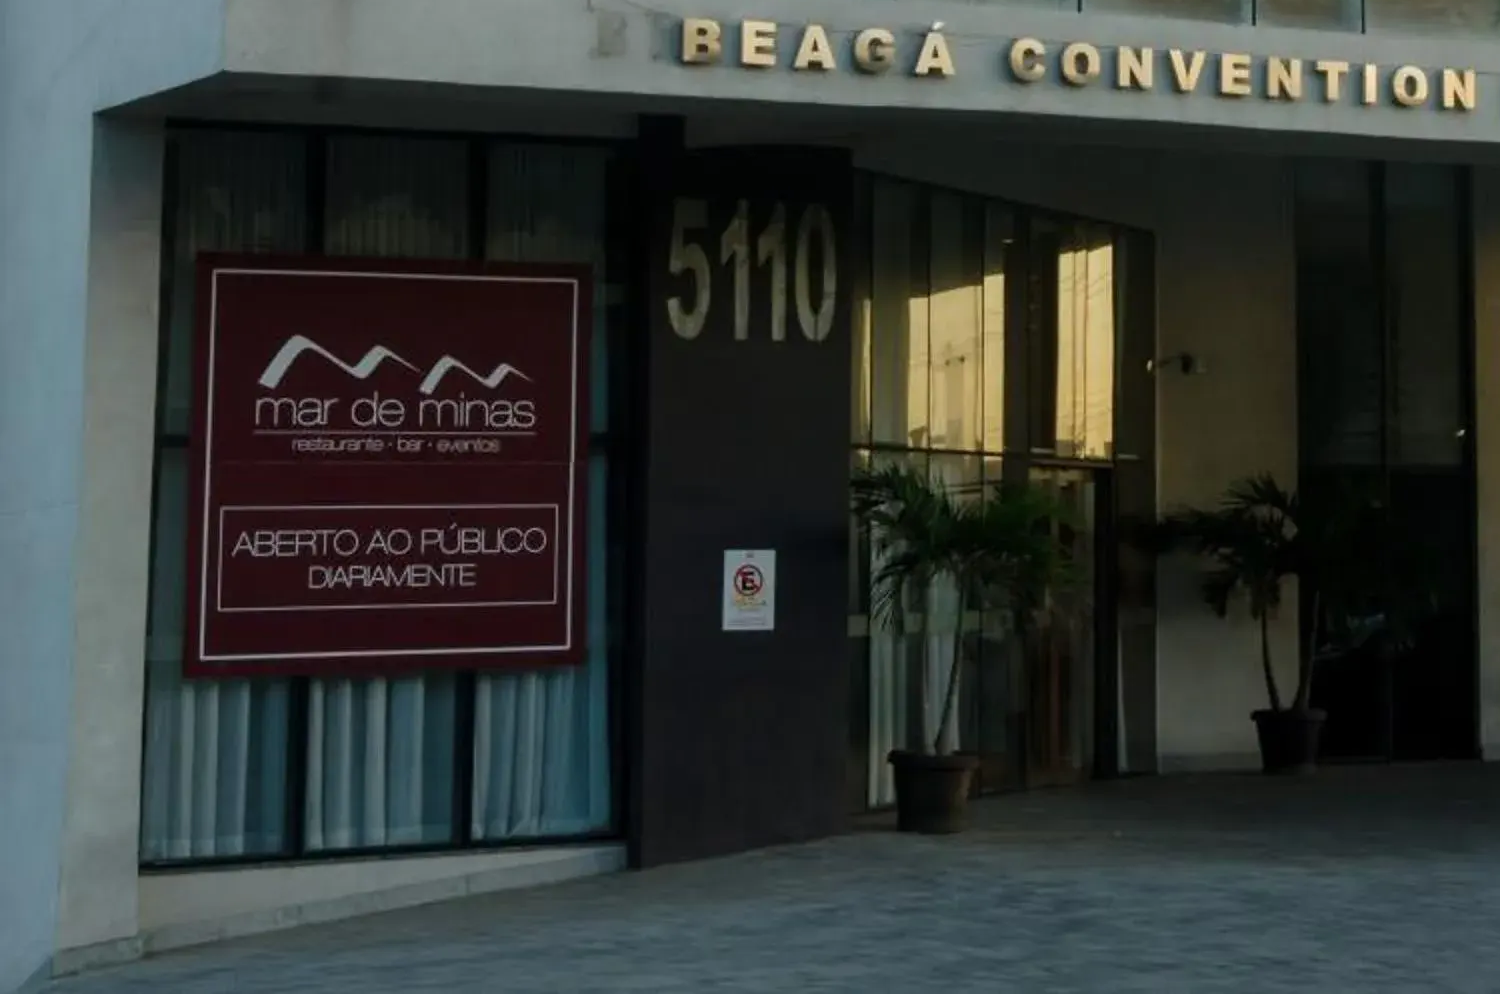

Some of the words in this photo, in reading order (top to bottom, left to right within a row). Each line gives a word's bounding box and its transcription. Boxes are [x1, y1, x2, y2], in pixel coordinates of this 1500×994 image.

[681, 18, 956, 77] BEAGÁ
[1008, 37, 1477, 111] CONVENTION
[667, 197, 837, 343] 5110
[254, 396, 339, 427] mar
[351, 391, 406, 428] de
[419, 391, 537, 430] minas
[291, 435, 385, 453] restaurante
[396, 435, 424, 453] bar
[436, 436, 500, 454] eventos
[231, 528, 359, 558] ABERTO
[365, 528, 413, 556] AO
[419, 523, 548, 555] PÚBLICO
[307, 562, 477, 590] DIARIAMENTE
